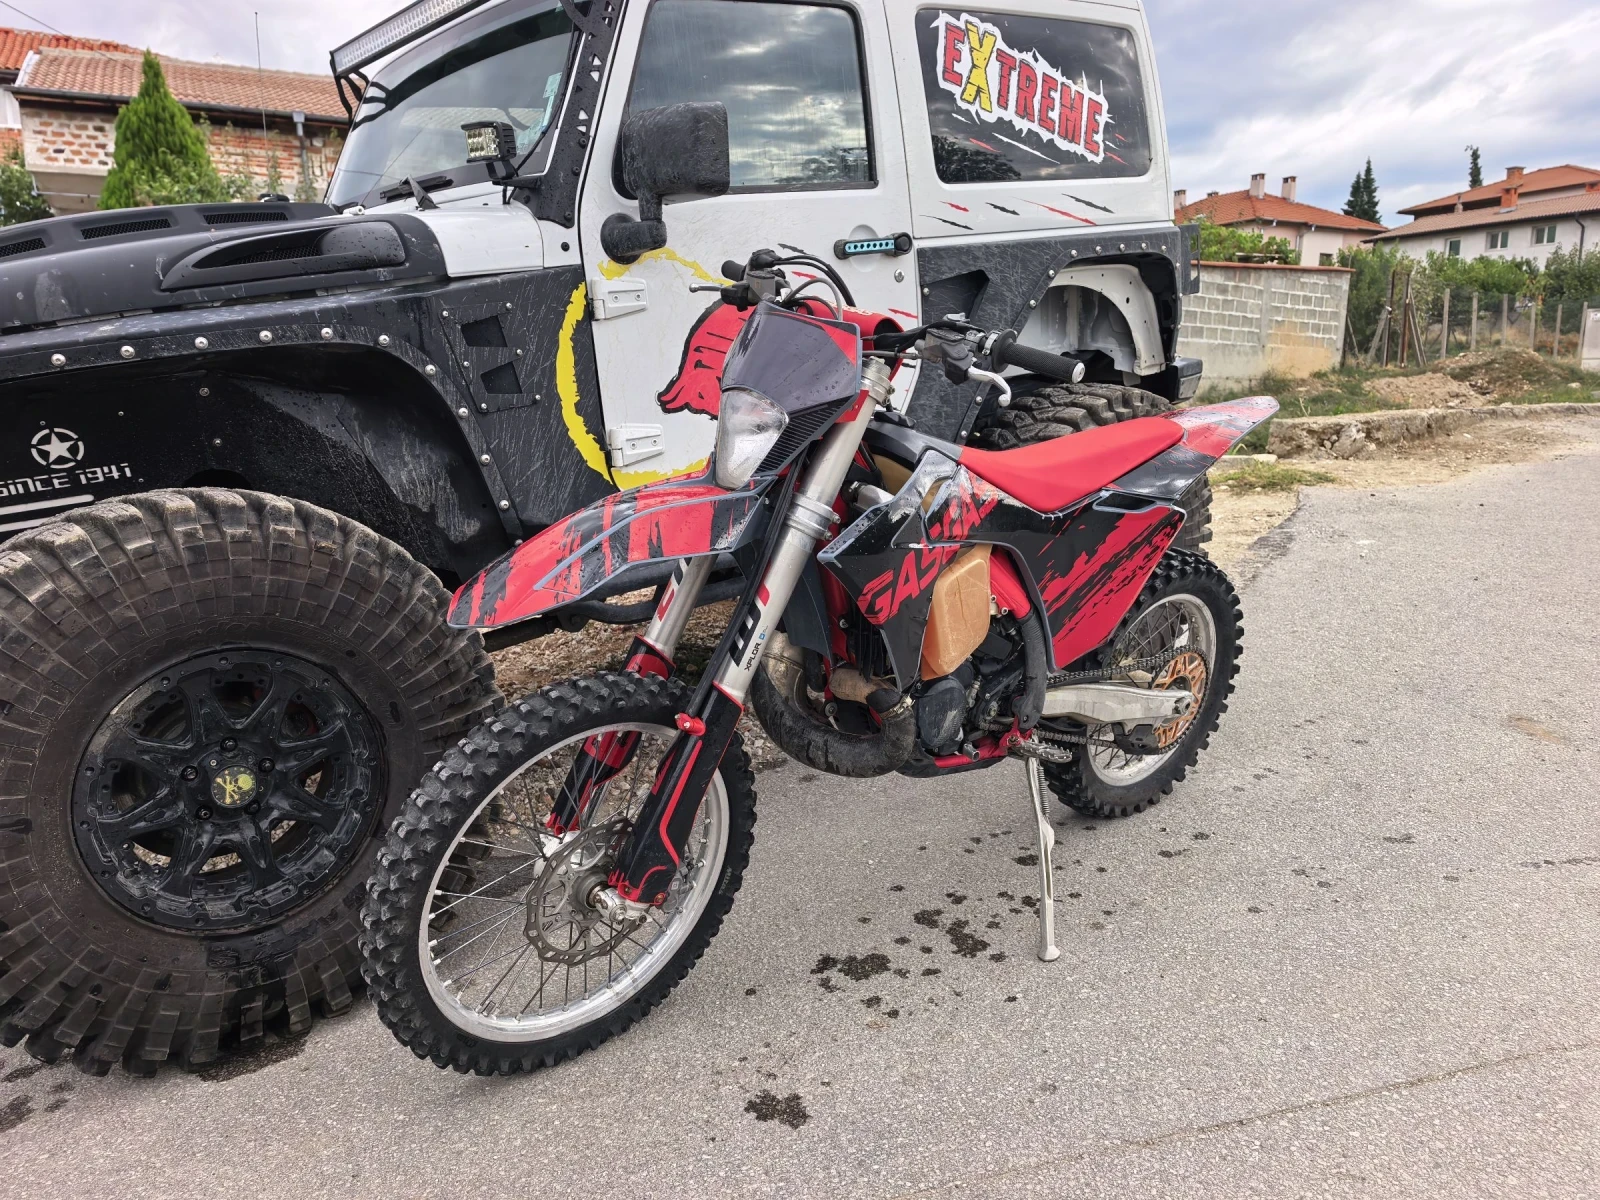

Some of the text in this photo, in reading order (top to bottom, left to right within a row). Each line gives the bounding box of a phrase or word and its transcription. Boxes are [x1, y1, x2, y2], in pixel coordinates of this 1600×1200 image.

[942, 19, 1103, 157] EXTREME
[75, 462, 132, 485] 1941
[744, 642, 762, 672] XPLOR
